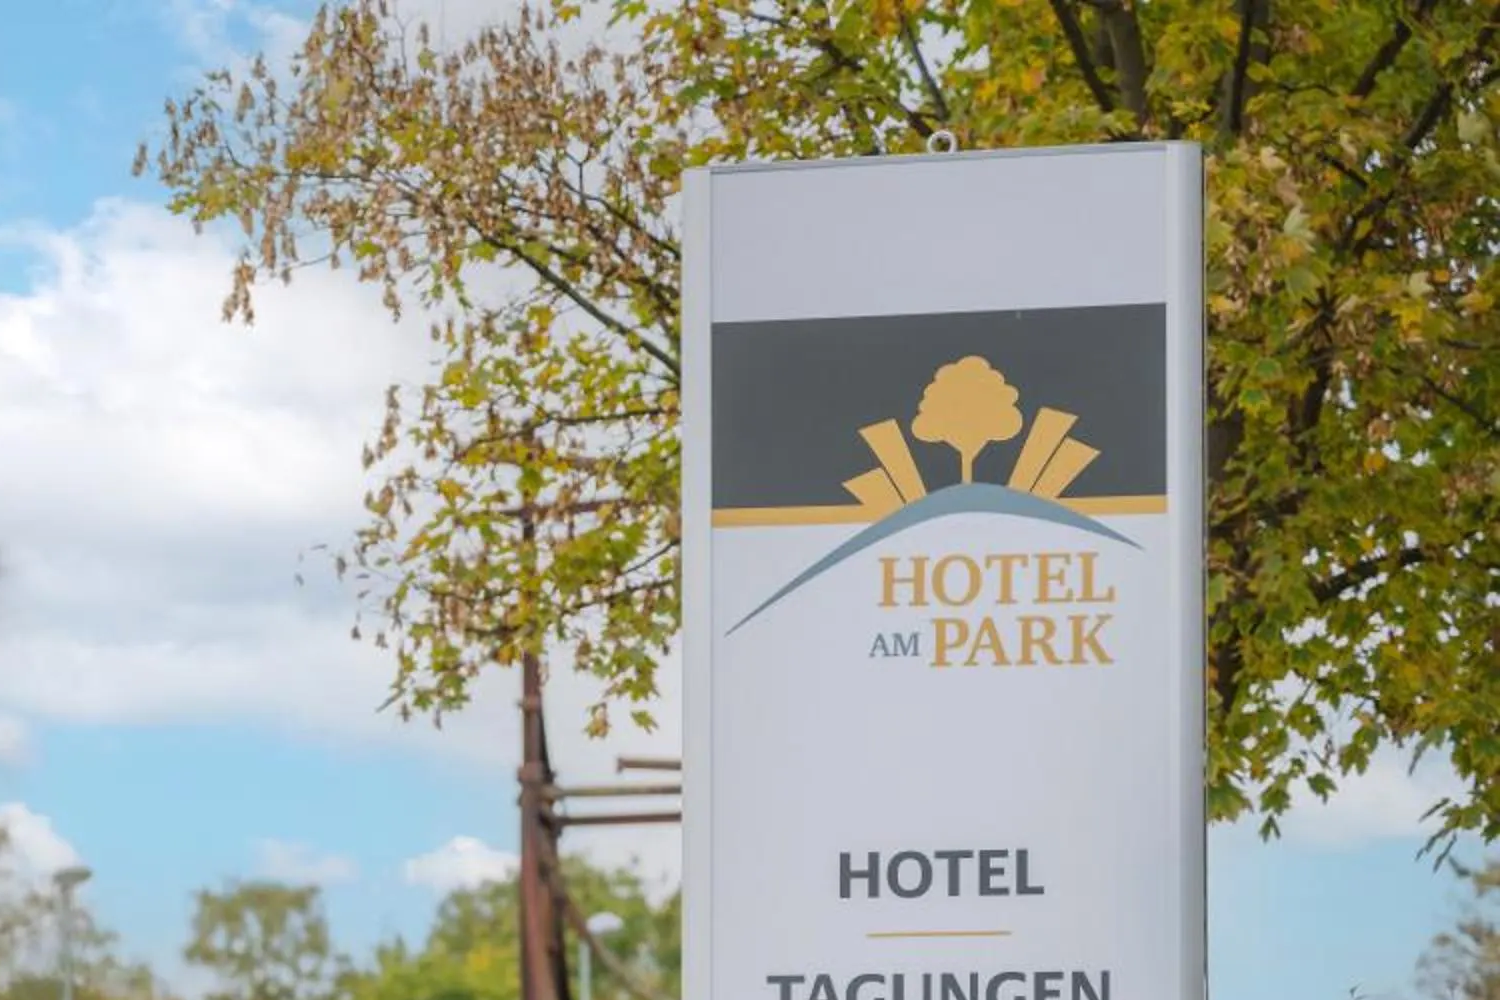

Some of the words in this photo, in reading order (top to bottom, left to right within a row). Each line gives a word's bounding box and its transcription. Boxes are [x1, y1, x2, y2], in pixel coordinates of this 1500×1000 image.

[878, 551, 1115, 608] HOTEL
[868, 632, 921, 659] AM
[930, 614, 1114, 668] PARK
[838, 848, 1045, 900] HOTEL
